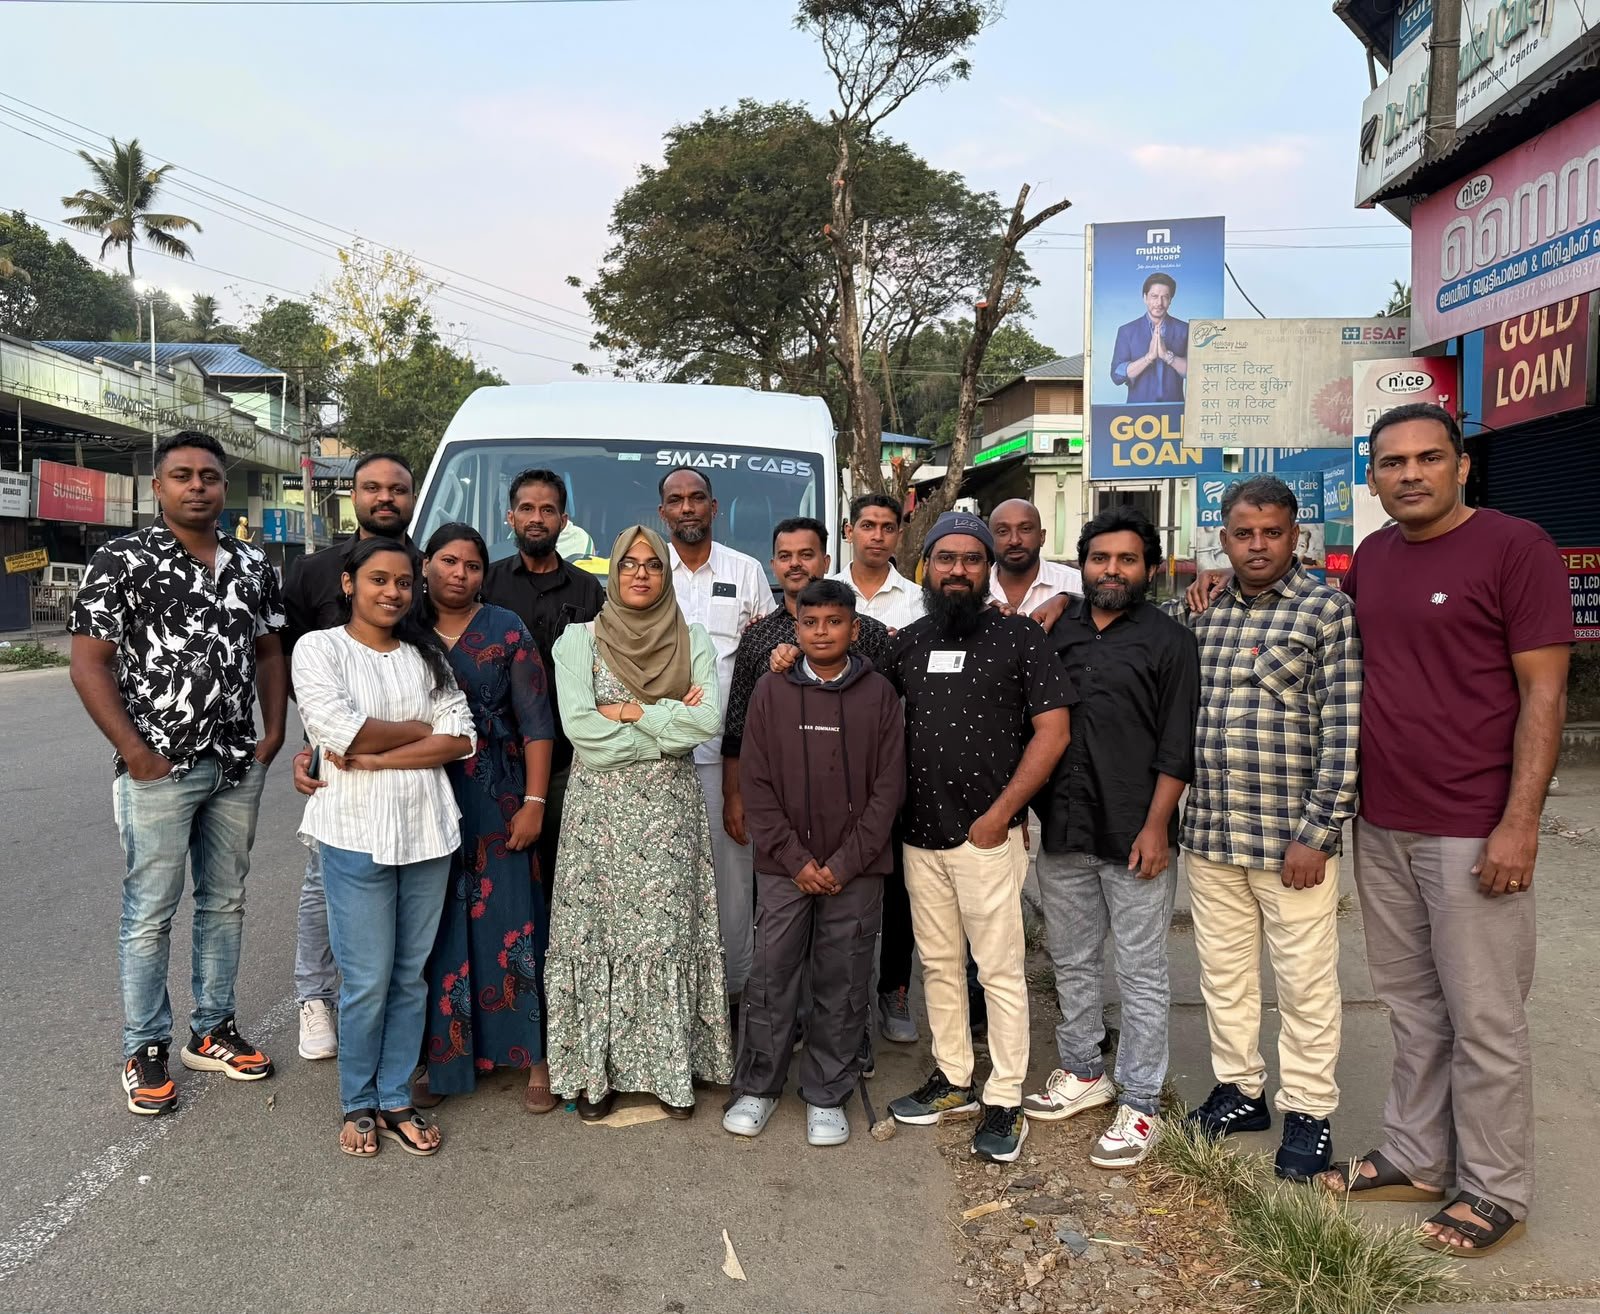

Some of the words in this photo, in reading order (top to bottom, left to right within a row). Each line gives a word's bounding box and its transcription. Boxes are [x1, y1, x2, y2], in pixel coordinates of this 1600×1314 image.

[1470, 86, 1477, 99] &
[1478, 61, 1508, 94] Implant
[1510, 39, 1539, 68] Centre
[1462, 181, 1487, 203] nice
[1136, 245, 1182, 255] muthoot
[1146, 254, 1180, 262] FINCORP
[1531, 254, 1538, 272] &
[1363, 326, 1407, 340] ESAF
[1242, 361, 1274, 374] टिकट
[1496, 344, 1573, 407] LOAN
[1225, 377, 1256, 391] टिकट
[1388, 372, 1424, 388] nice
[1201, 398, 1220, 408] बस
[1244, 395, 1277, 408] टिकट
[1110, 415, 1184, 440] GOL
[1112, 441, 1202, 466] LOAN
[656, 451, 741, 469] SMART
[748, 456, 812, 477] CABS
[53, 483, 94, 501] SUNIDRA
[1298, 479, 1319, 490] Care
[1587, 593, 1600, 606] CO
[1576, 611, 1583, 624] &
[1584, 610, 1598, 624] ALL
[1134, 1118, 1149, 1137] N
